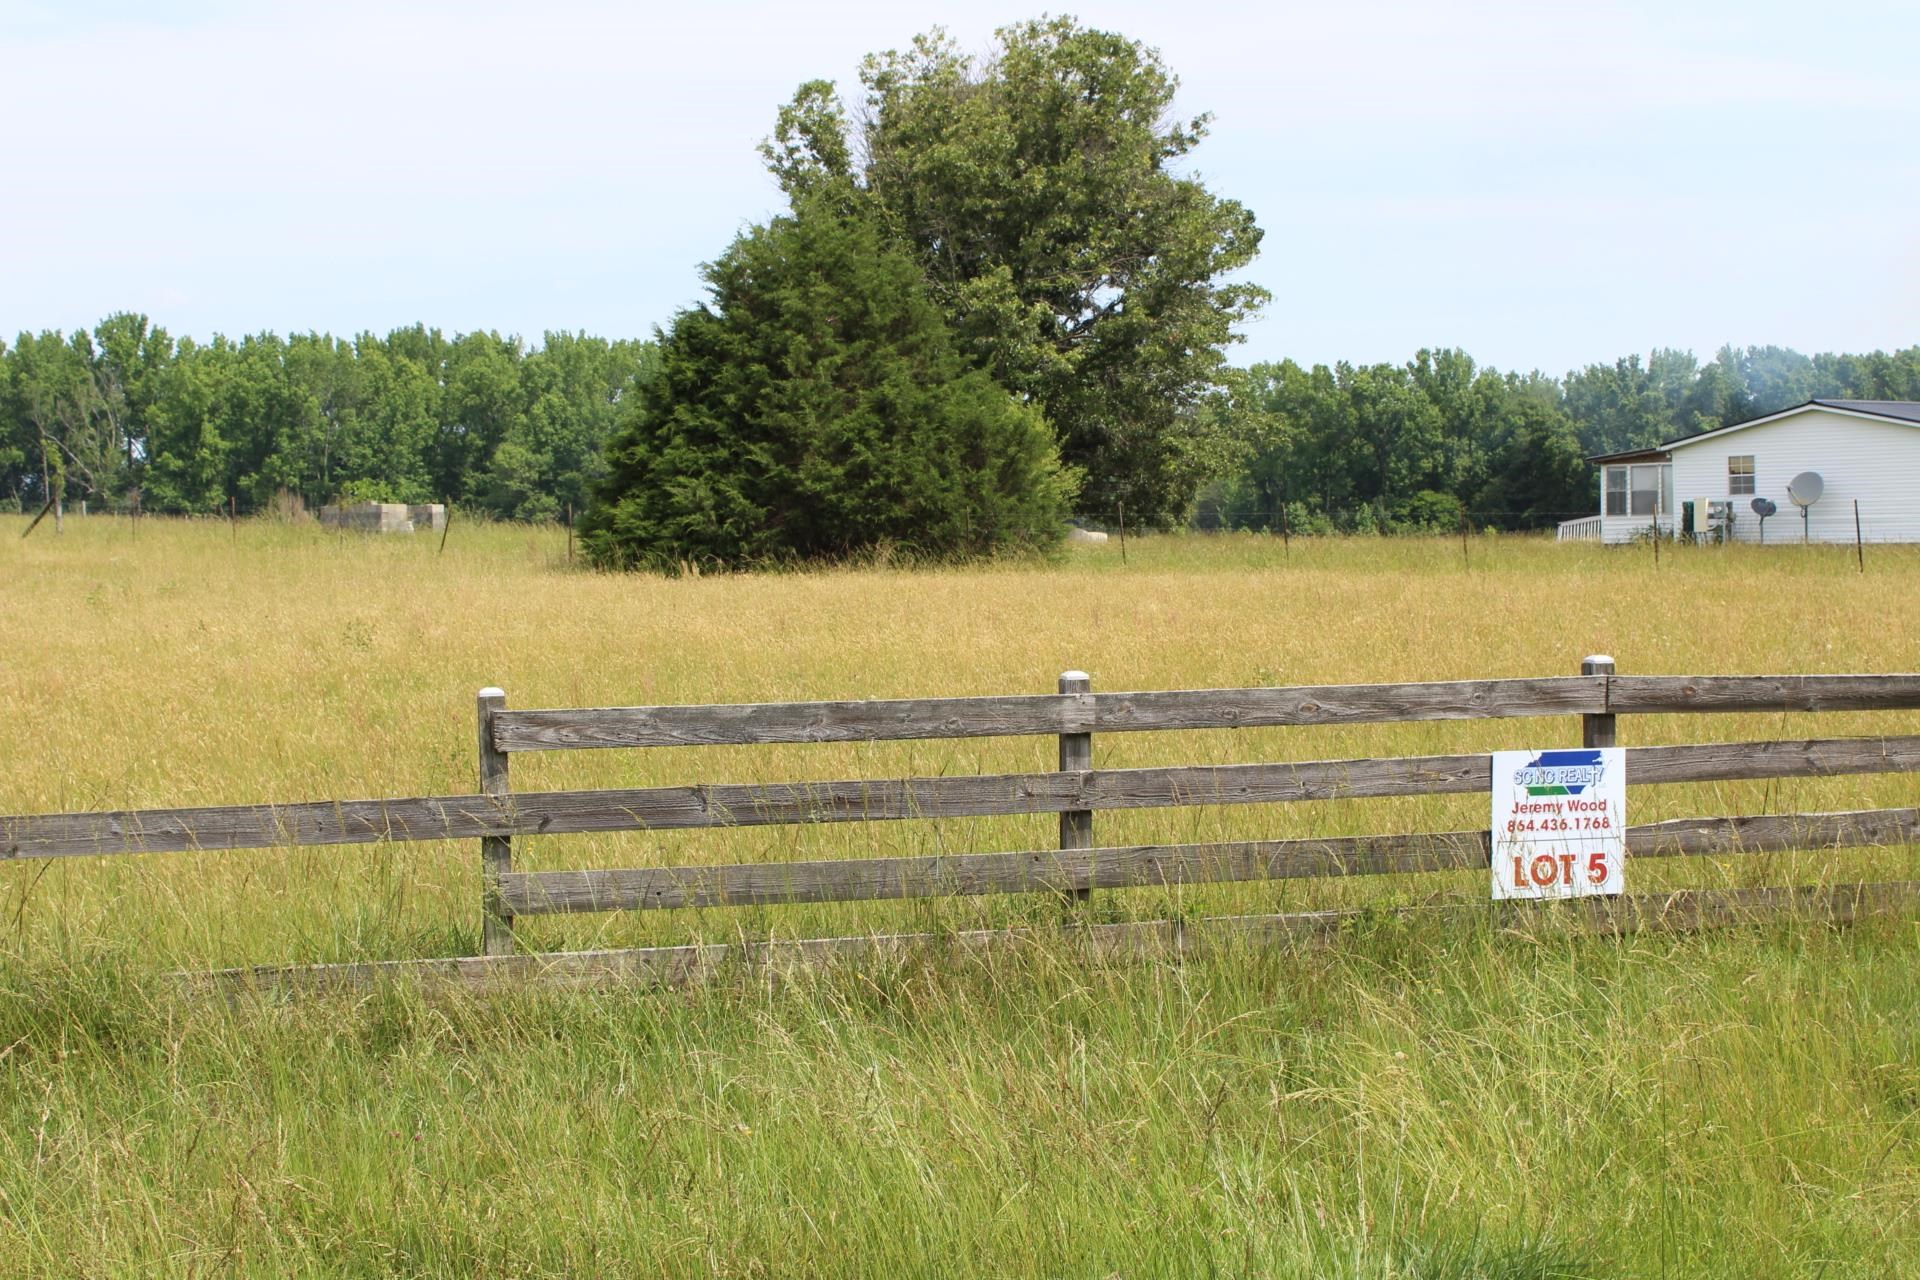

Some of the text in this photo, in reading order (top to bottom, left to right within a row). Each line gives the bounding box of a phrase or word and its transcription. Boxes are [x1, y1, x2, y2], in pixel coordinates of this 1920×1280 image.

[1512, 799, 1607, 815] Jeremy Wood
[1507, 817, 1610, 833] 864.436.1768
[1513, 853, 1608, 888] LOT 5
